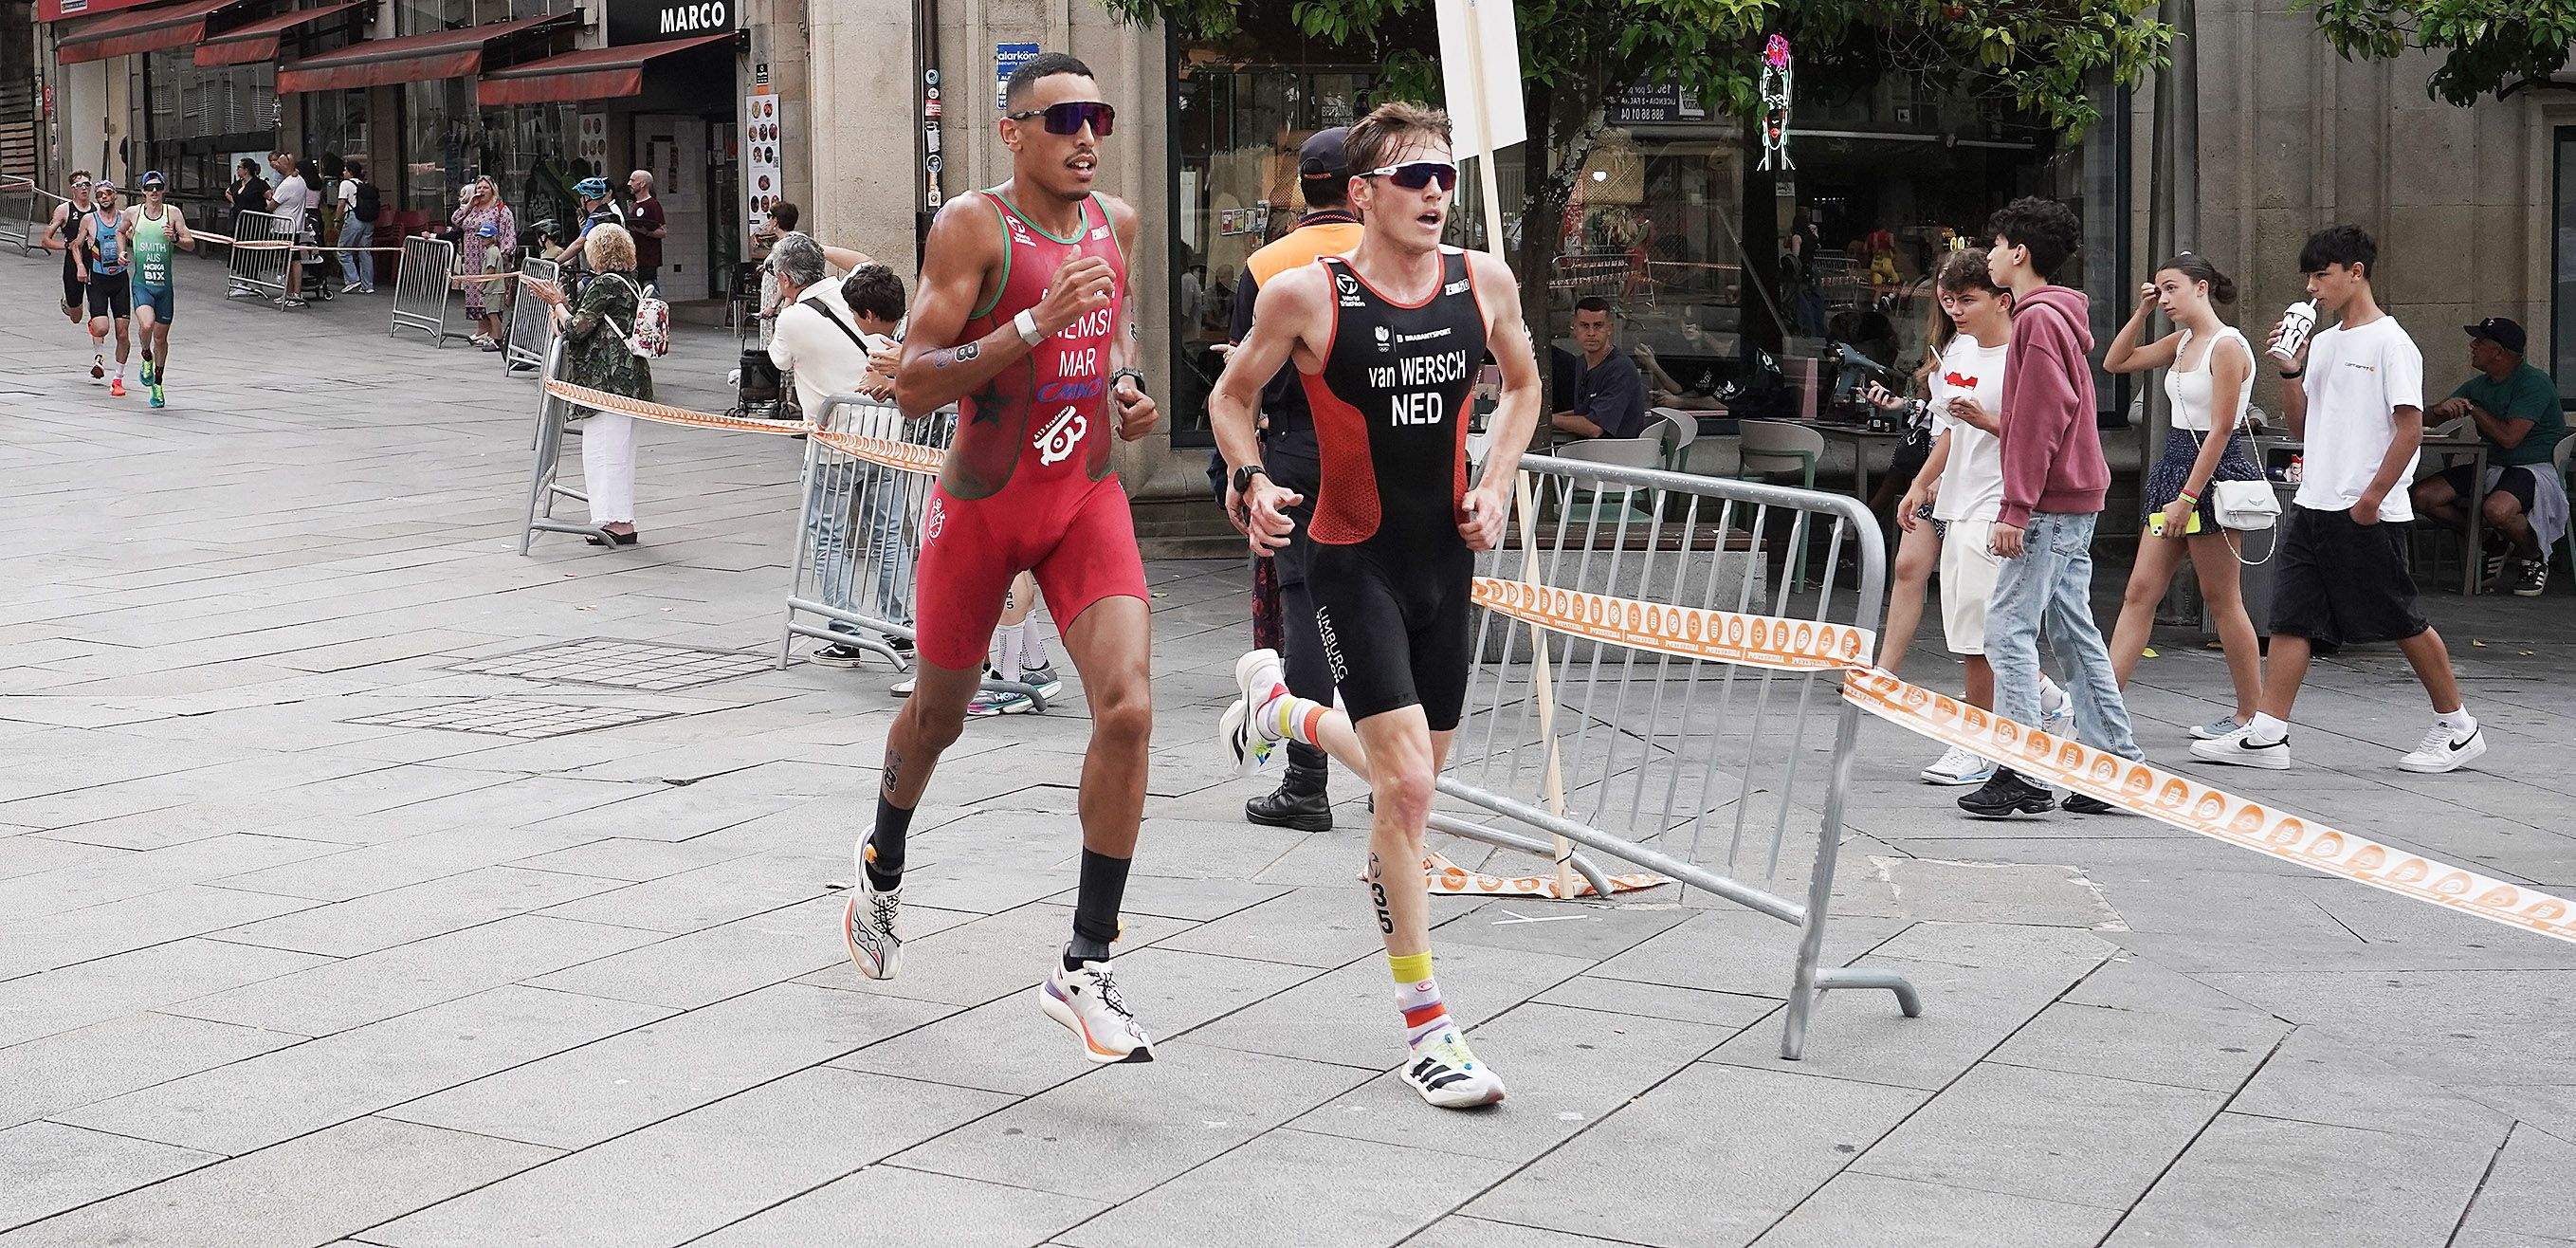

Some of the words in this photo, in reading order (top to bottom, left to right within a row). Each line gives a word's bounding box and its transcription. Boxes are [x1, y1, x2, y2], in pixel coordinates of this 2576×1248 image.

[660, 1, 725, 33] MARCO
[139, 242, 167, 253] SMITH
[146, 253, 161, 262] AUS
[143, 263, 165, 271] HOKA
[144, 271, 165, 280] BIX
[1058, 347, 1096, 377] MAR
[1368, 366, 1396, 388] van
[1399, 349, 1466, 386] WERSCH
[1045, 405, 1069, 430] Academy
[1391, 392, 1443, 427] NED
[1319, 606, 1348, 680] LIMBURG
[1371, 882, 1395, 934] 35
